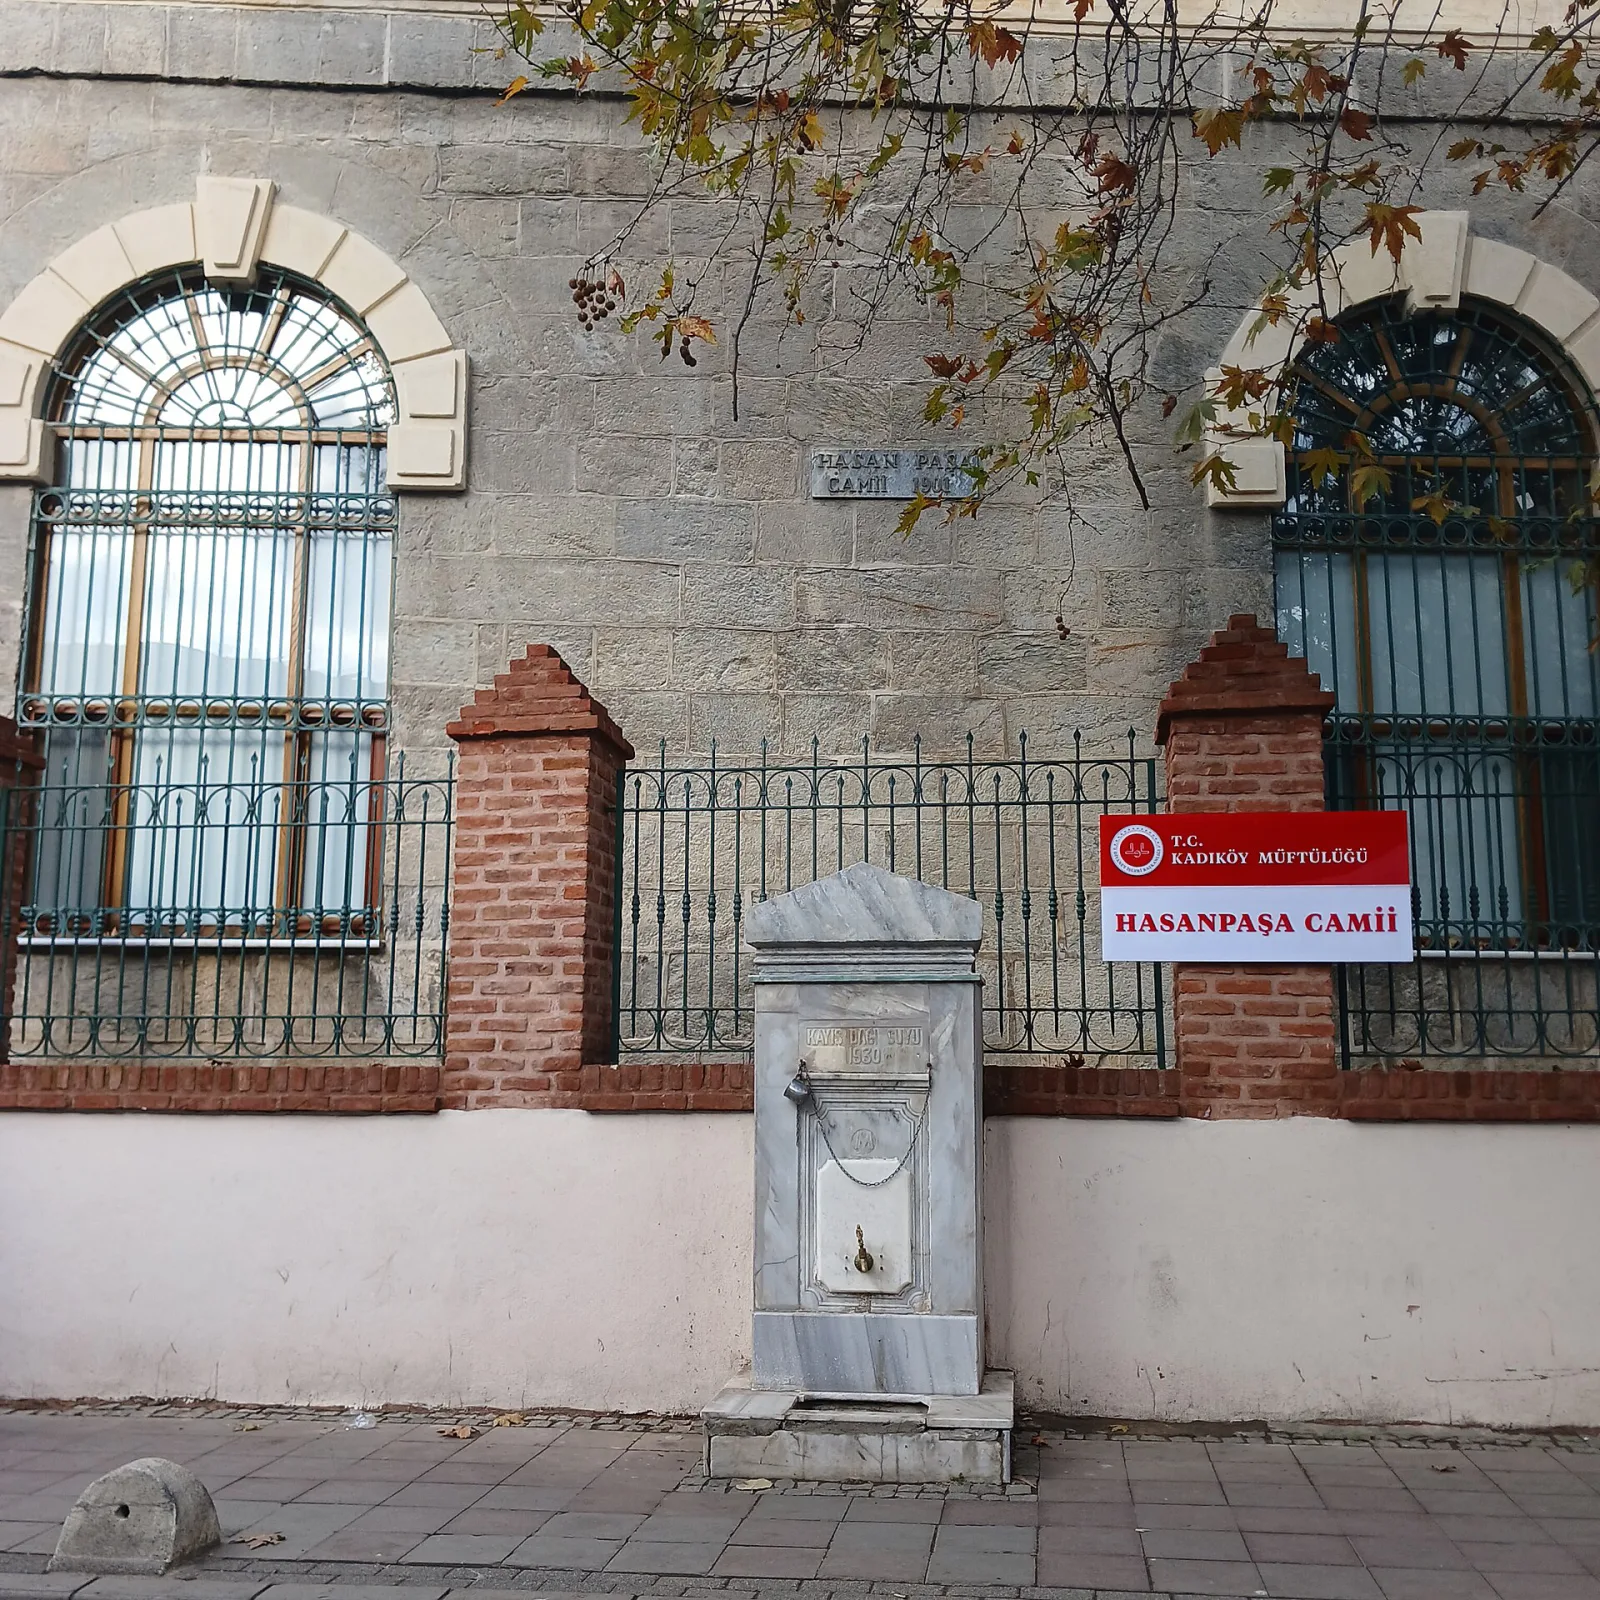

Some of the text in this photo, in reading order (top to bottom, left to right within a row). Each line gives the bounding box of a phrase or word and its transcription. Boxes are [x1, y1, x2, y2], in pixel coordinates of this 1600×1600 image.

[817, 453, 898, 470] HASAN
[1170, 834, 1204, 848] T.C.
[1170, 847, 1368, 865] KADIKÖY MÜFTÜLÜĞÜ
[1115, 906, 1398, 936] HASANPAŞA CAMİİ
[887, 1028, 922, 1046] SUYU
[848, 1047, 882, 1065] 1930
